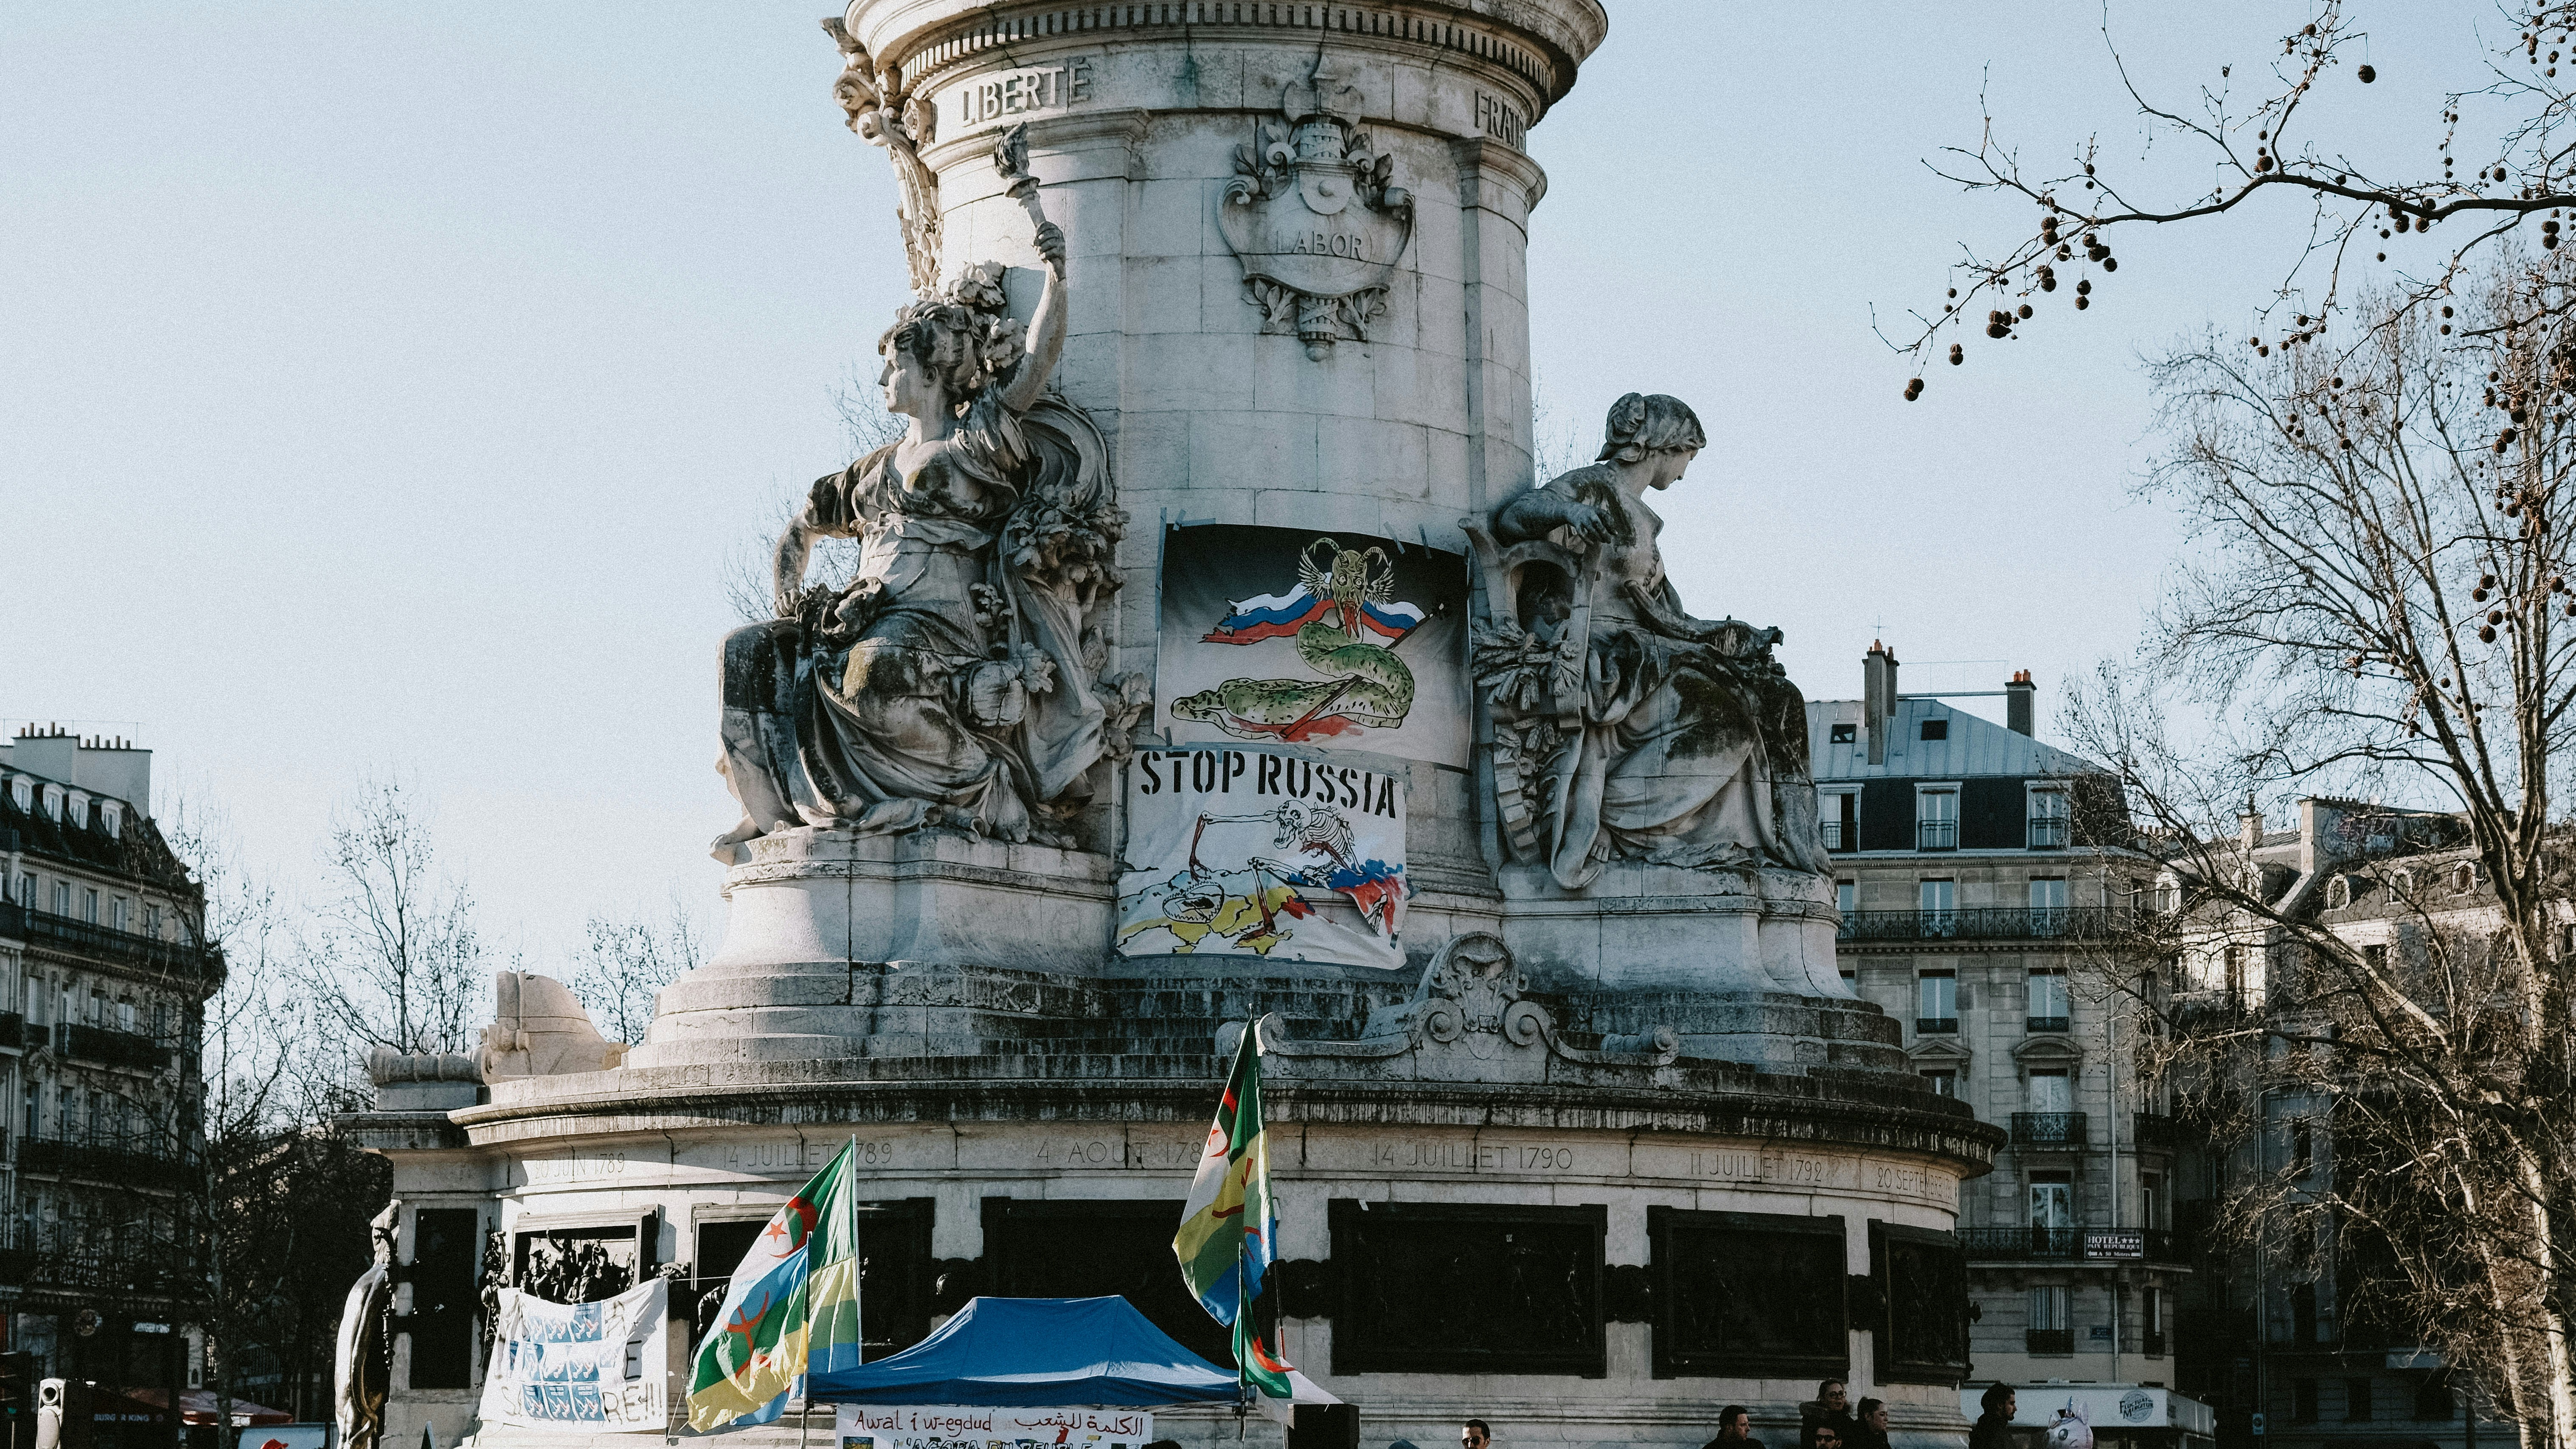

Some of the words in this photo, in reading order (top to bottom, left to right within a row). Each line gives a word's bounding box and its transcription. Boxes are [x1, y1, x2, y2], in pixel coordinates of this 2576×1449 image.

[962, 57, 1093, 127] LIBERTÉ
[1276, 231, 1363, 261] LABOR
[1141, 750, 1245, 795] STOP
[1258, 753, 1396, 819] RUSSIA
[724, 1146, 738, 1168] 14
[747, 1144, 836, 1166] JUILLET
[855, 1143, 892, 1164] 789
[1037, 1142, 1049, 1163] 4
[1371, 1144, 1393, 1165] 14
[1407, 1145, 1509, 1168] JUILLET
[1519, 1147, 1572, 1169] 1790
[535, 1159, 549, 1179] 20
[554, 1156, 586, 1177] JUIN
[595, 1153, 625, 1174] 1789
[1690, 1153, 1701, 1175] 11
[1710, 1154, 1783, 1179] JUILLET
[1790, 1159, 1822, 1182] 1792
[1878, 1167, 1892, 1188] 20
[1896, 1170, 1942, 1196] SEPTEMBRE
[2088, 1236, 2121, 1244] HOTEL
[855, 1410, 903, 1431] Awal
[910, 1412, 918, 1431] i
[924, 1413, 992, 1438] w-egdud
[1014, 1412, 1082, 1430] للشعب
[1087, 1415, 1143, 1437] الكلمة
